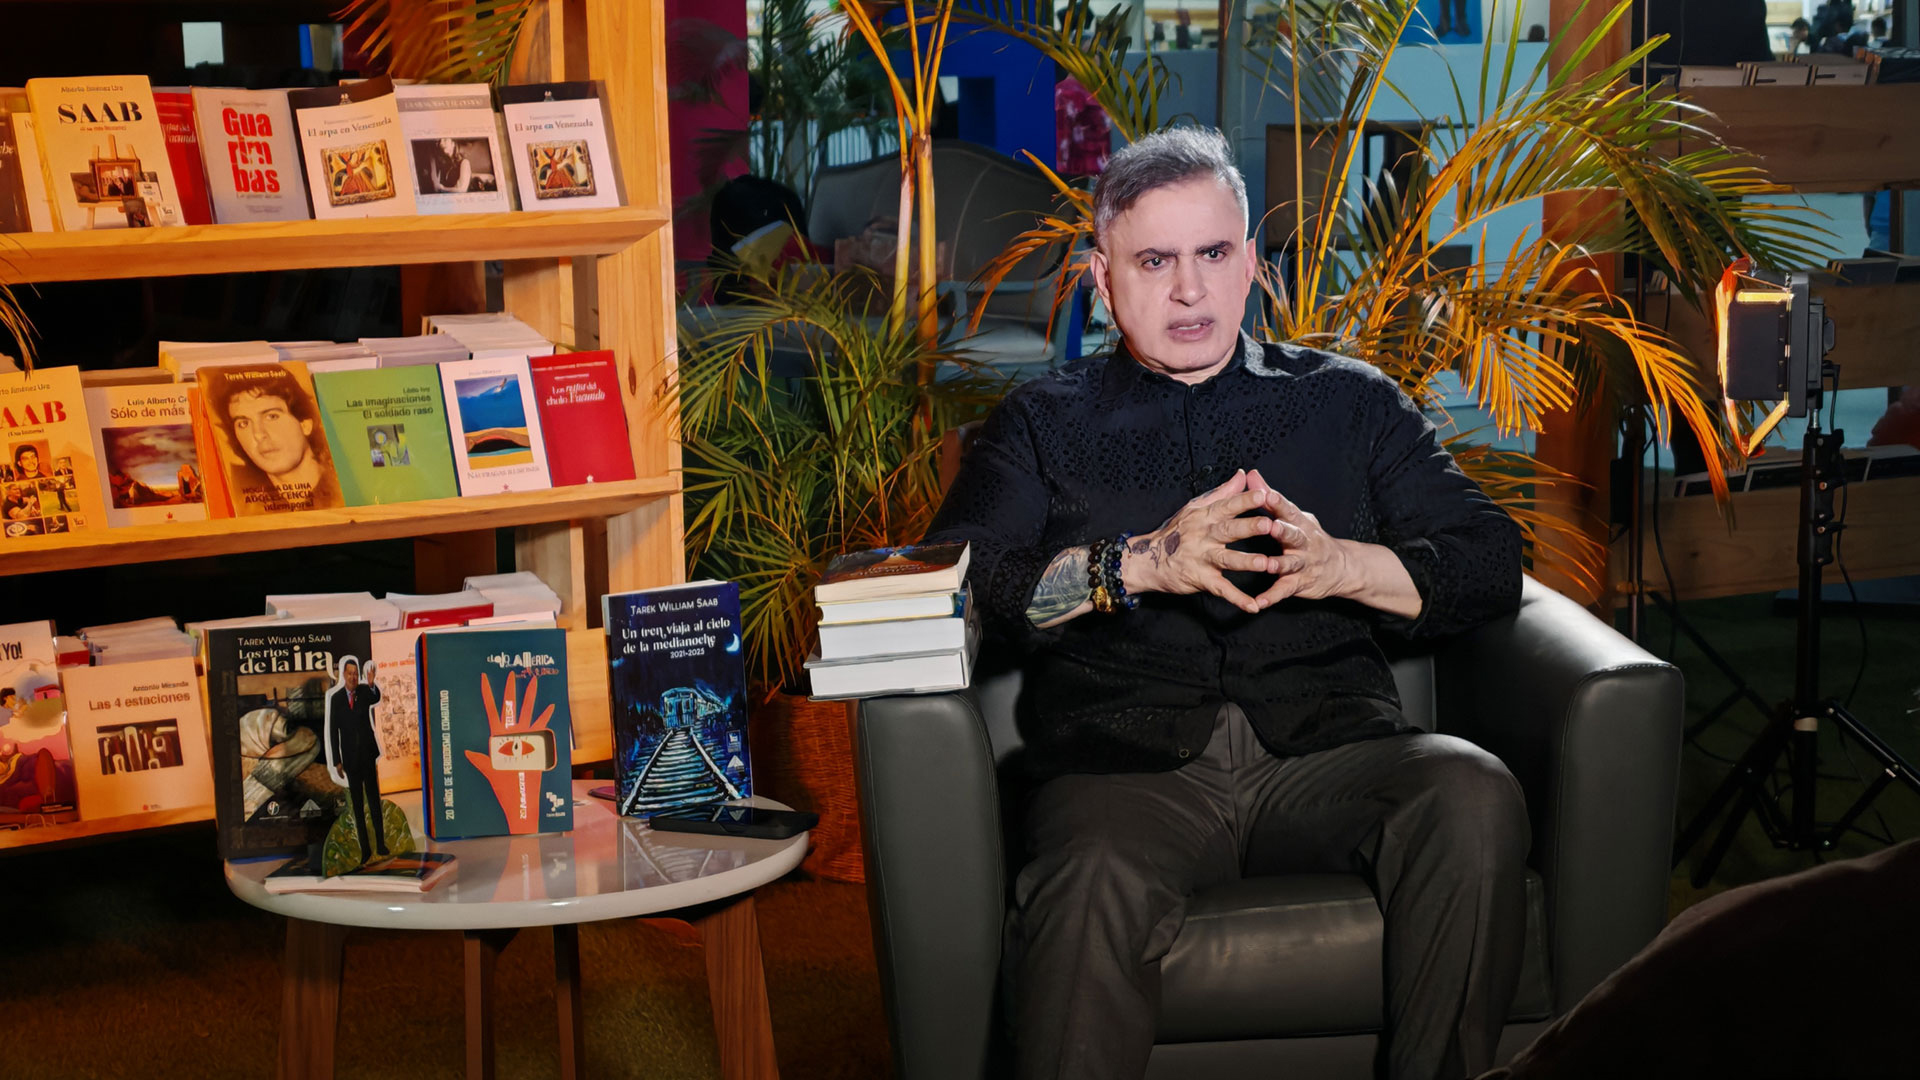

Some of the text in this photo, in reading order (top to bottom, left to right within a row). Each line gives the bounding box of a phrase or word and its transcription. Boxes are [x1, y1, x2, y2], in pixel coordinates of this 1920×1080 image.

[58, 101, 142, 124] SAAB
[222, 107, 273, 137] Gua
[307, 128, 317, 137] El
[319, 128, 338, 138] arpa
[340, 126, 350, 134] en
[352, 116, 392, 132] Venezuela
[514, 123, 523, 132] El
[525, 123, 542, 133] arpa
[555, 118, 593, 129] Venezuela
[232, 163, 280, 193] bas
[127, 398, 145, 406] Luis
[147, 396, 176, 405] Alberto
[346, 395, 432, 409] Las imaginaciones
[110, 404, 185, 419] Sólo de más
[362, 406, 434, 419] El soldado raso
[282, 483, 293, 491] DE
[294, 482, 312, 490] UNA
[630, 597, 719, 617] TAREK WILLIAM SAAB
[621, 628, 637, 640] Un
[666, 621, 690, 636] viaja
[693, 619, 703, 632] al
[706, 617, 731, 630] cielo
[238, 633, 332, 647] TAREK WILLIAM SAAB
[622, 633, 716, 655] de la medianoche
[239, 648, 262, 660] Los
[670, 647, 705, 659] 2021-2025
[240, 645, 338, 680] de la ira
[133, 684, 160, 692] Antonio
[89, 692, 191, 711] Las 4 estaciones
[443, 777, 453, 787] DE
[446, 809, 455, 821] 20
